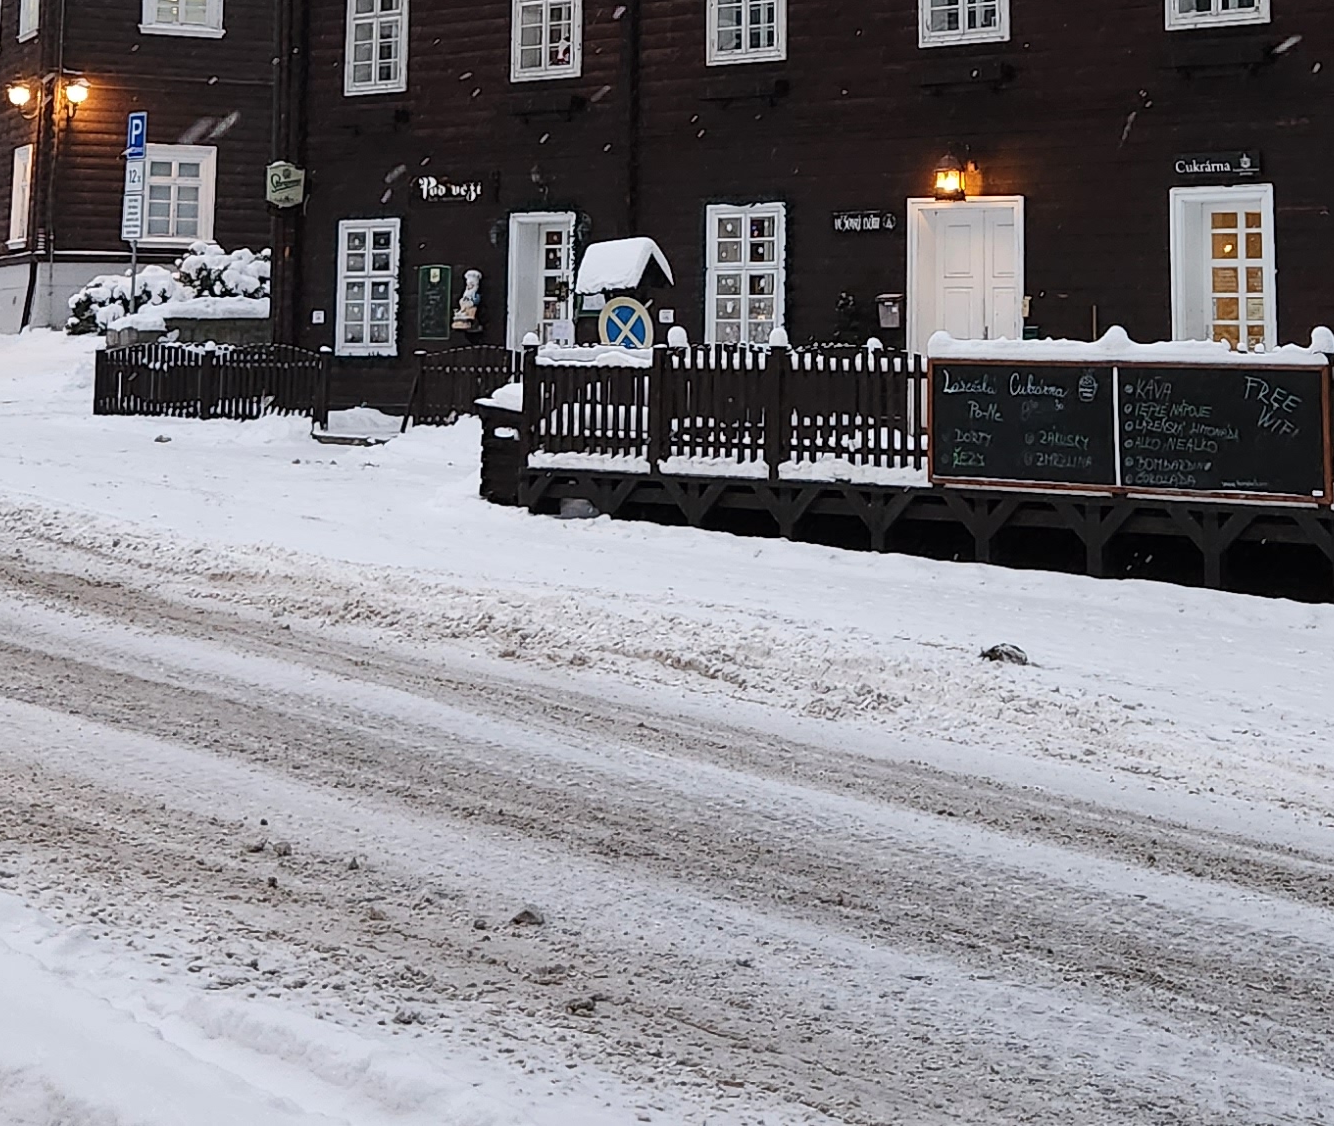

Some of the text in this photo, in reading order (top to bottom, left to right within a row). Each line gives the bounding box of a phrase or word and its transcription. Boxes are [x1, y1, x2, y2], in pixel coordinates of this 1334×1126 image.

[131, 119, 143, 145] P
[1175, 159, 1231, 174] Cukrárna
[418, 176, 447, 200] Pod
[1244, 375, 1303, 414] FREE
